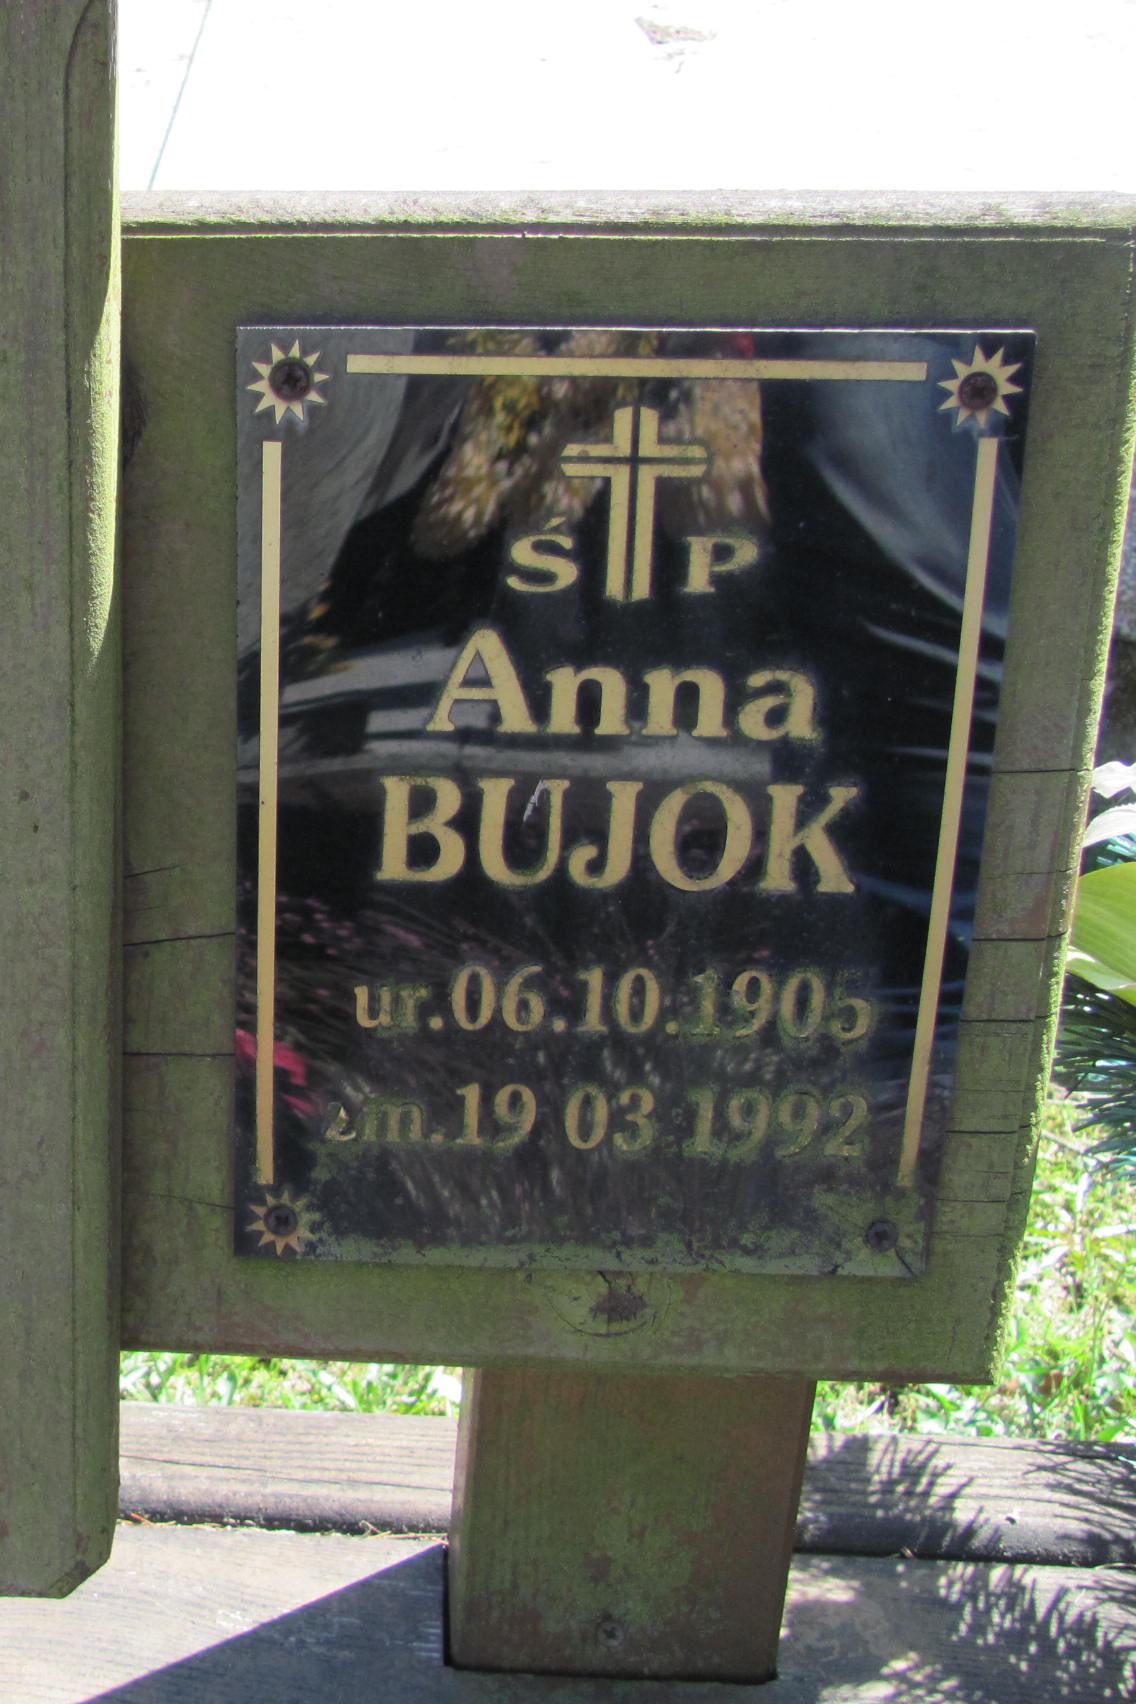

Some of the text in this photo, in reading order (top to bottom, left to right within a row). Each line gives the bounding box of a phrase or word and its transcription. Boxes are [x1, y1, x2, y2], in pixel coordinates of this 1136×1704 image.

[506, 516, 760, 594] Ś P
[425, 628, 821, 742] Anna
[374, 775, 861, 894] BUJOK
